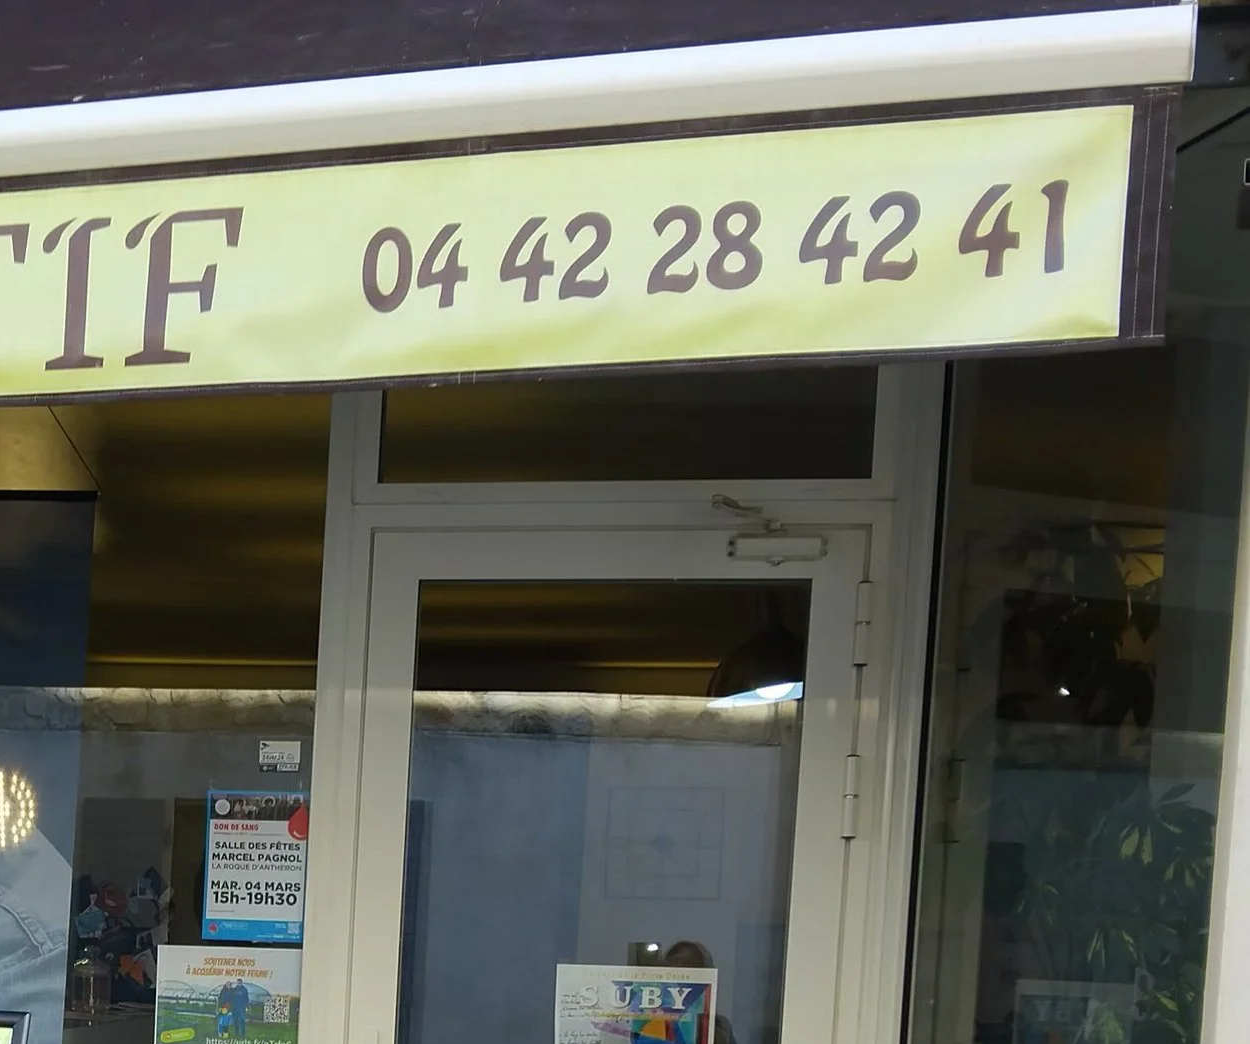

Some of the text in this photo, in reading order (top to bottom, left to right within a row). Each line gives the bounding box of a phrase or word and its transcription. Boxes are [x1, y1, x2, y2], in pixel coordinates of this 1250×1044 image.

[362, 178, 1070, 313] 04 42 28 42 41
[215, 841, 301, 851] SALLE DES FÊTES
[212, 853, 302, 863] MARCEL PAGNOL
[210, 880, 301, 892] MAR. 04 MARS
[213, 891, 297, 906] 15h-19h30
